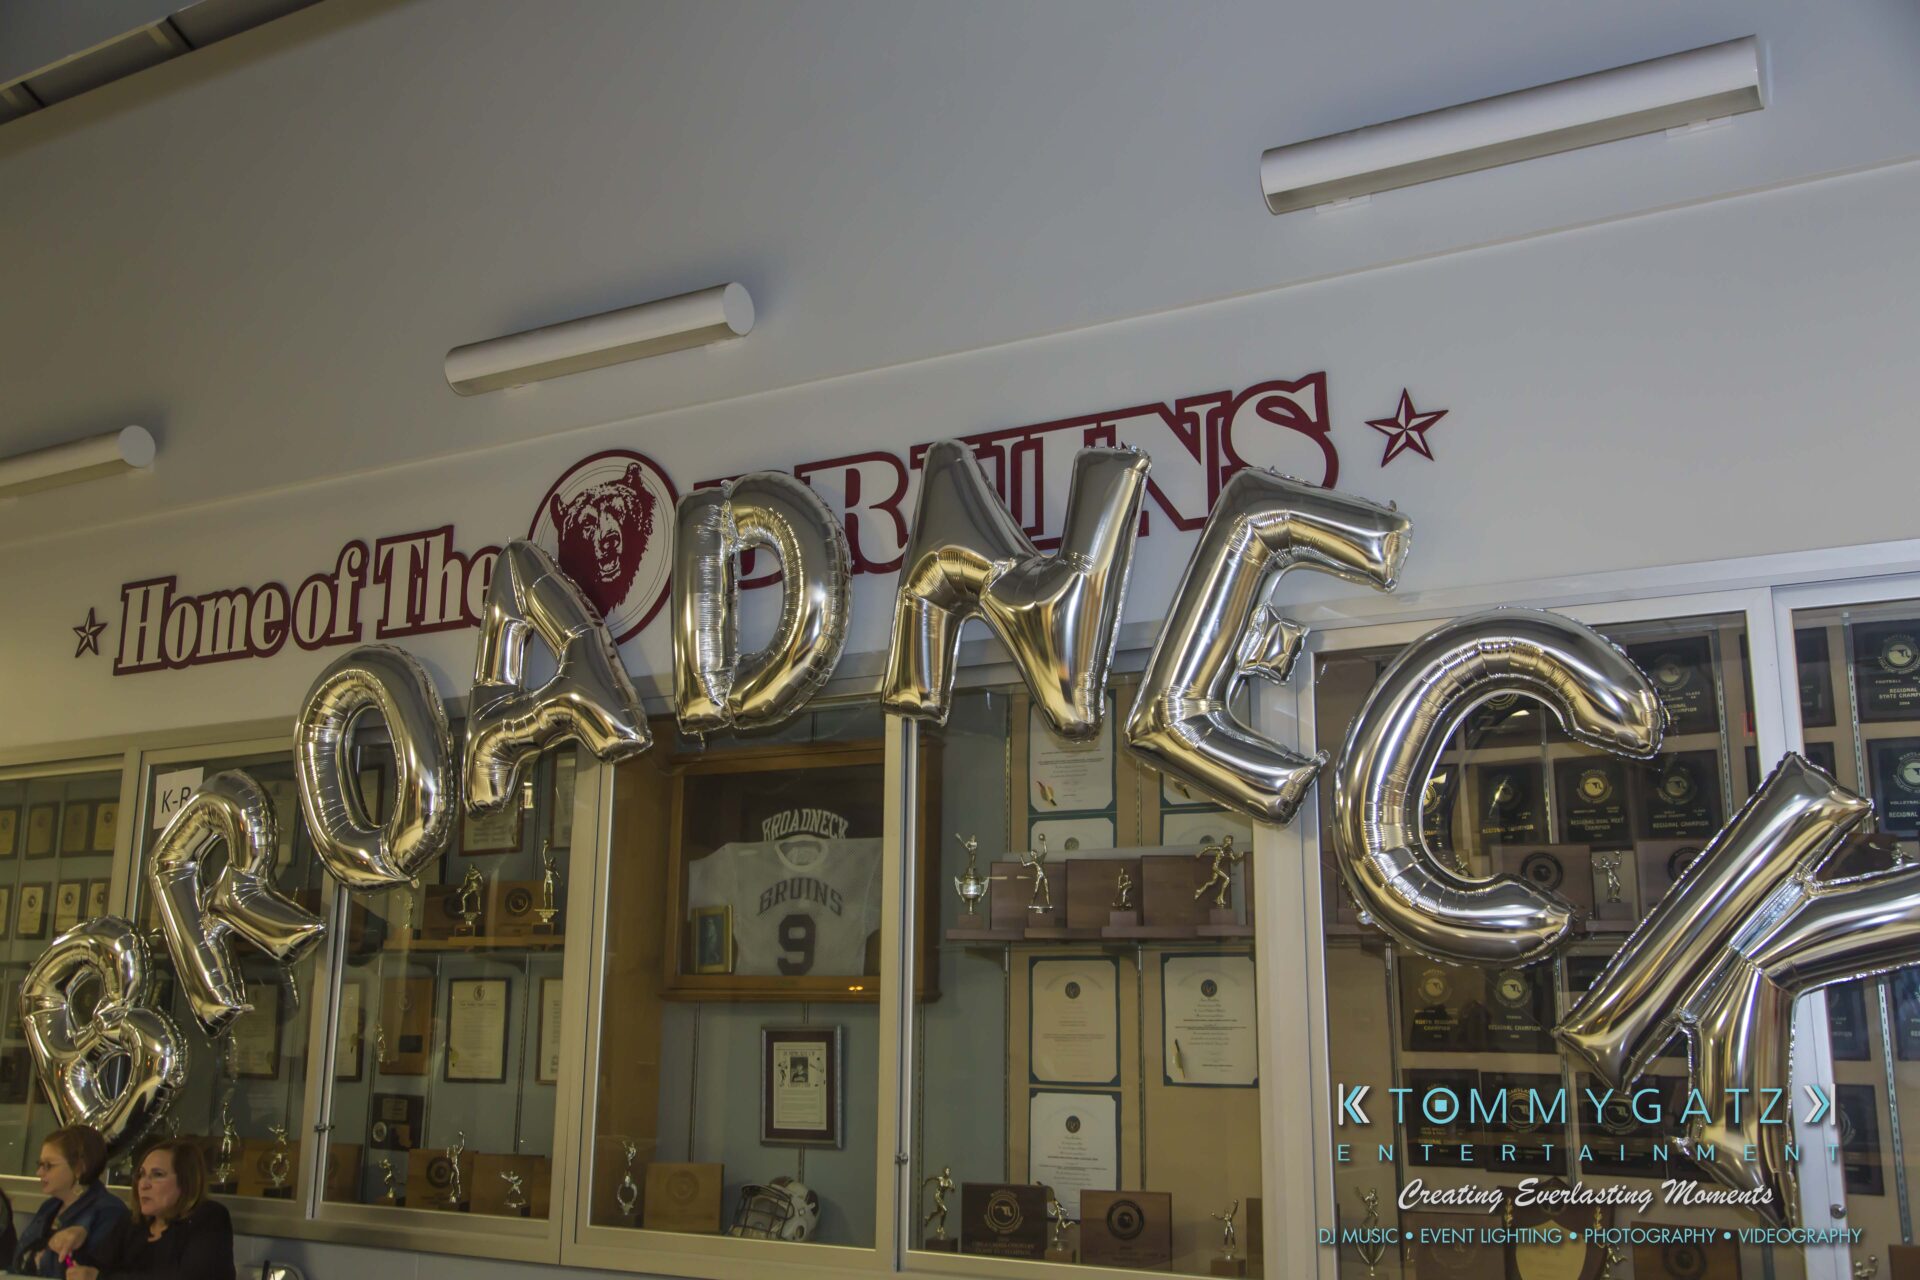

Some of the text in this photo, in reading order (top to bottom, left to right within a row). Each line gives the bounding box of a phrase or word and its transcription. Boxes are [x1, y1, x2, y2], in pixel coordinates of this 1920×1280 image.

[113, 575, 290, 676] Home
[291, 539, 369, 651] of
[373, 524, 504, 639] The
[761, 808, 849, 841] BROADNECK
[757, 877, 843, 917] BRUINS
[777, 914, 817, 977] 9
